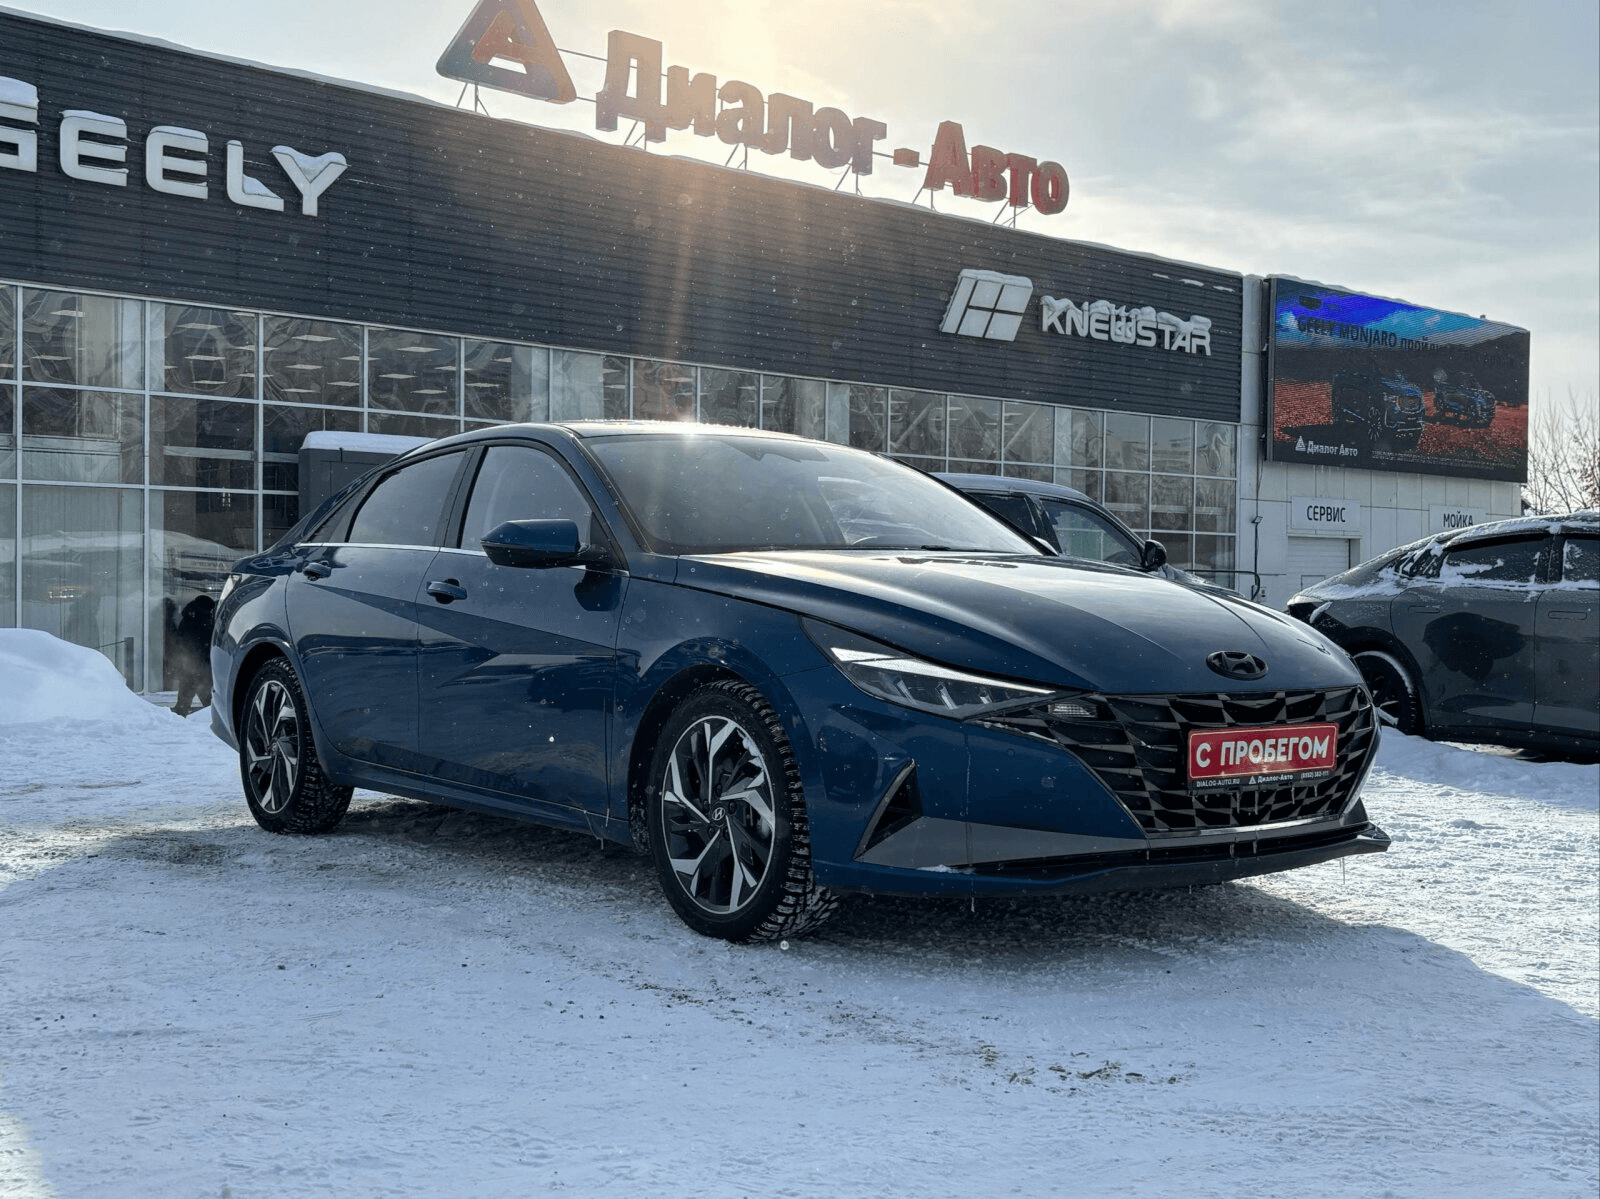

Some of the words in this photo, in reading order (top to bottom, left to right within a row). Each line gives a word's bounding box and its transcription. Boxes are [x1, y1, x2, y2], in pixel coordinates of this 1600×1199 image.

[1041, 297, 1212, 356] KNEWSTAR
[1339, 323, 1397, 348] MONJARO
[1307, 440, 1337, 455] Диалог
[1338, 443, 1358, 457] Авто
[1306, 505, 1346, 522] СЕРВИС
[1443, 510, 1474, 528] МОЙКА
[1196, 743, 1211, 768] С
[1220, 735, 1330, 766] ПРОБЕГОМ
[1196, 778, 1240, 788] DIALOG-AUTO.RU
